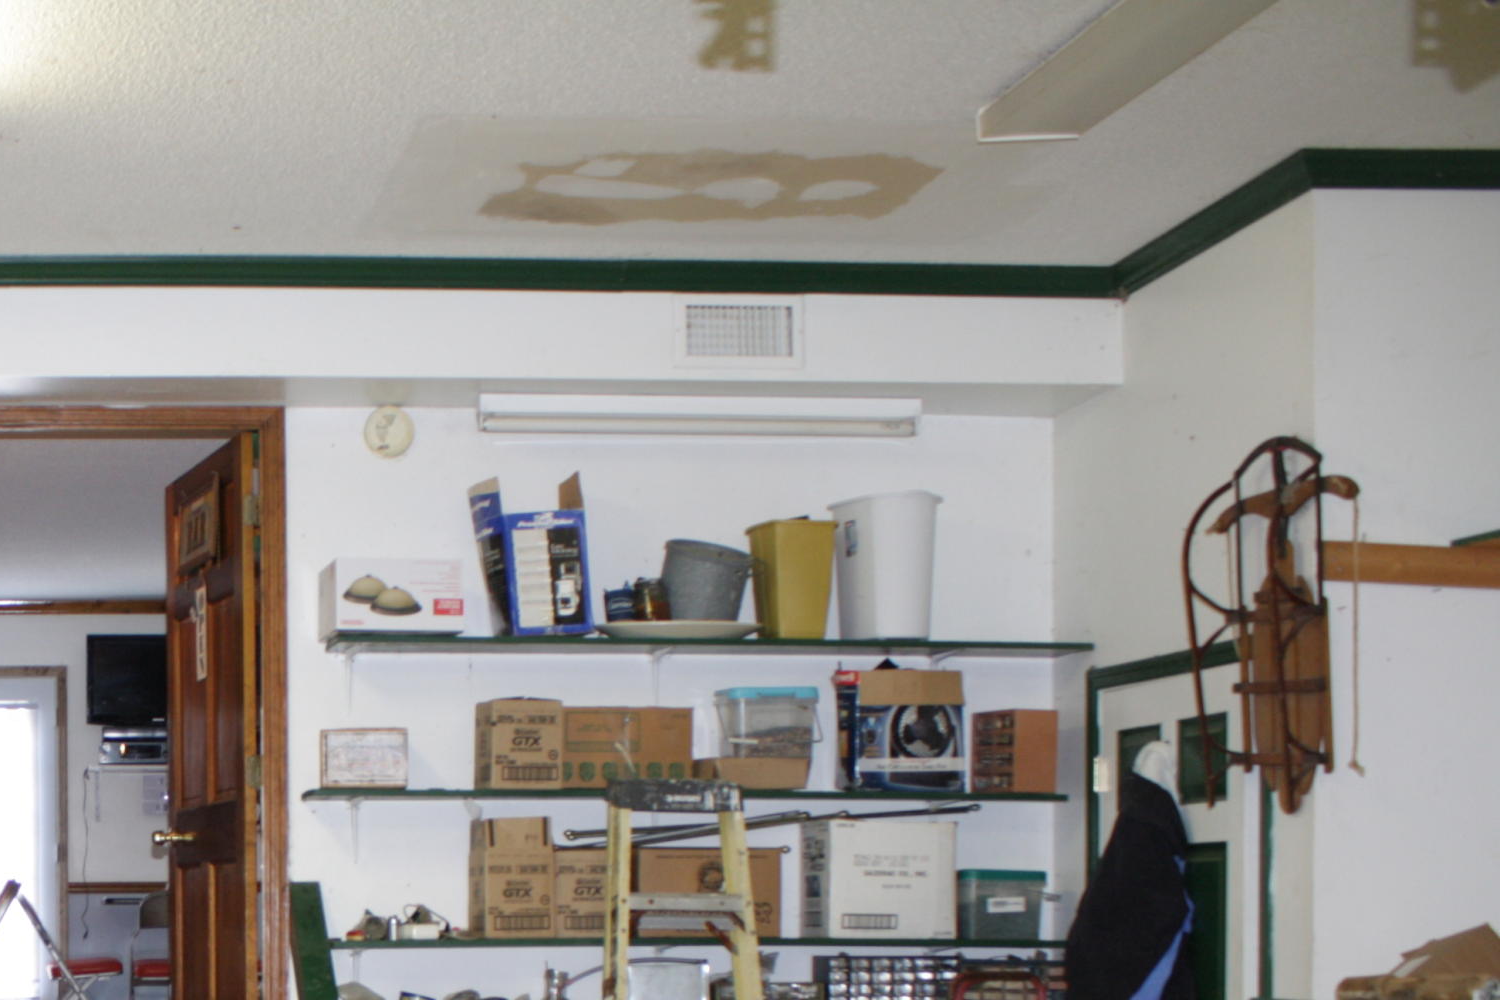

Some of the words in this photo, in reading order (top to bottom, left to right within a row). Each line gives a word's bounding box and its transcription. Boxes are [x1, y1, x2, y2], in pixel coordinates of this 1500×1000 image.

[512, 736, 541, 747] GTX
[503, 887, 532, 898] GTX
[574, 886, 603, 896] GTX
